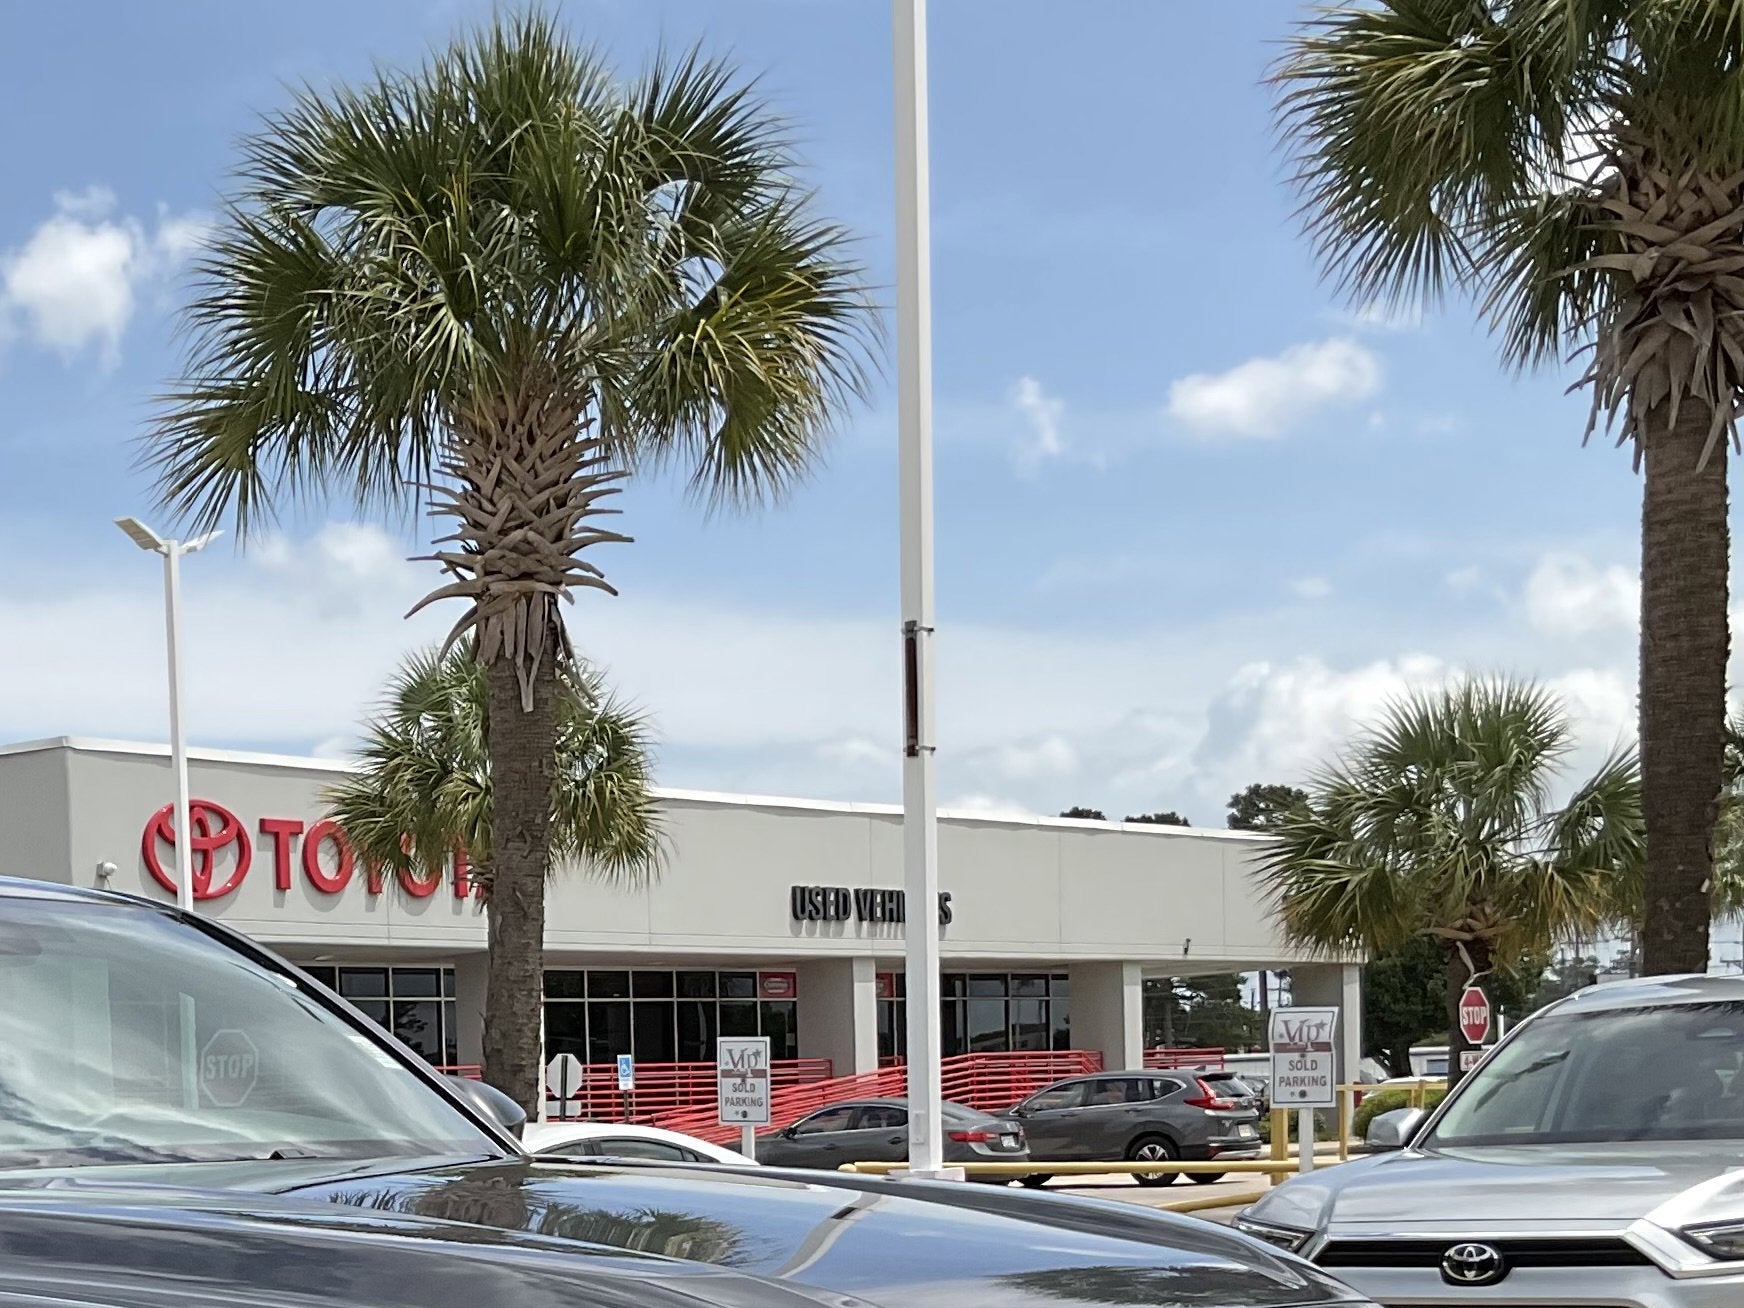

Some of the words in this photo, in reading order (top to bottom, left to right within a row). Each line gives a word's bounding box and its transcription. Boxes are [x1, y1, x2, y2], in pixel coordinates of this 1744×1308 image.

[791, 885, 852, 921] USED
[853, 888, 953, 925] VEHIS
[1462, 1006, 1487, 1026] STOP
[205, 1053, 254, 1080] STOP
[1288, 1059, 1318, 1072] SOLD
[731, 1082, 756, 1093] SOLD
[1278, 1075, 1327, 1088] PARKING
[724, 1096, 764, 1107] PARKING
